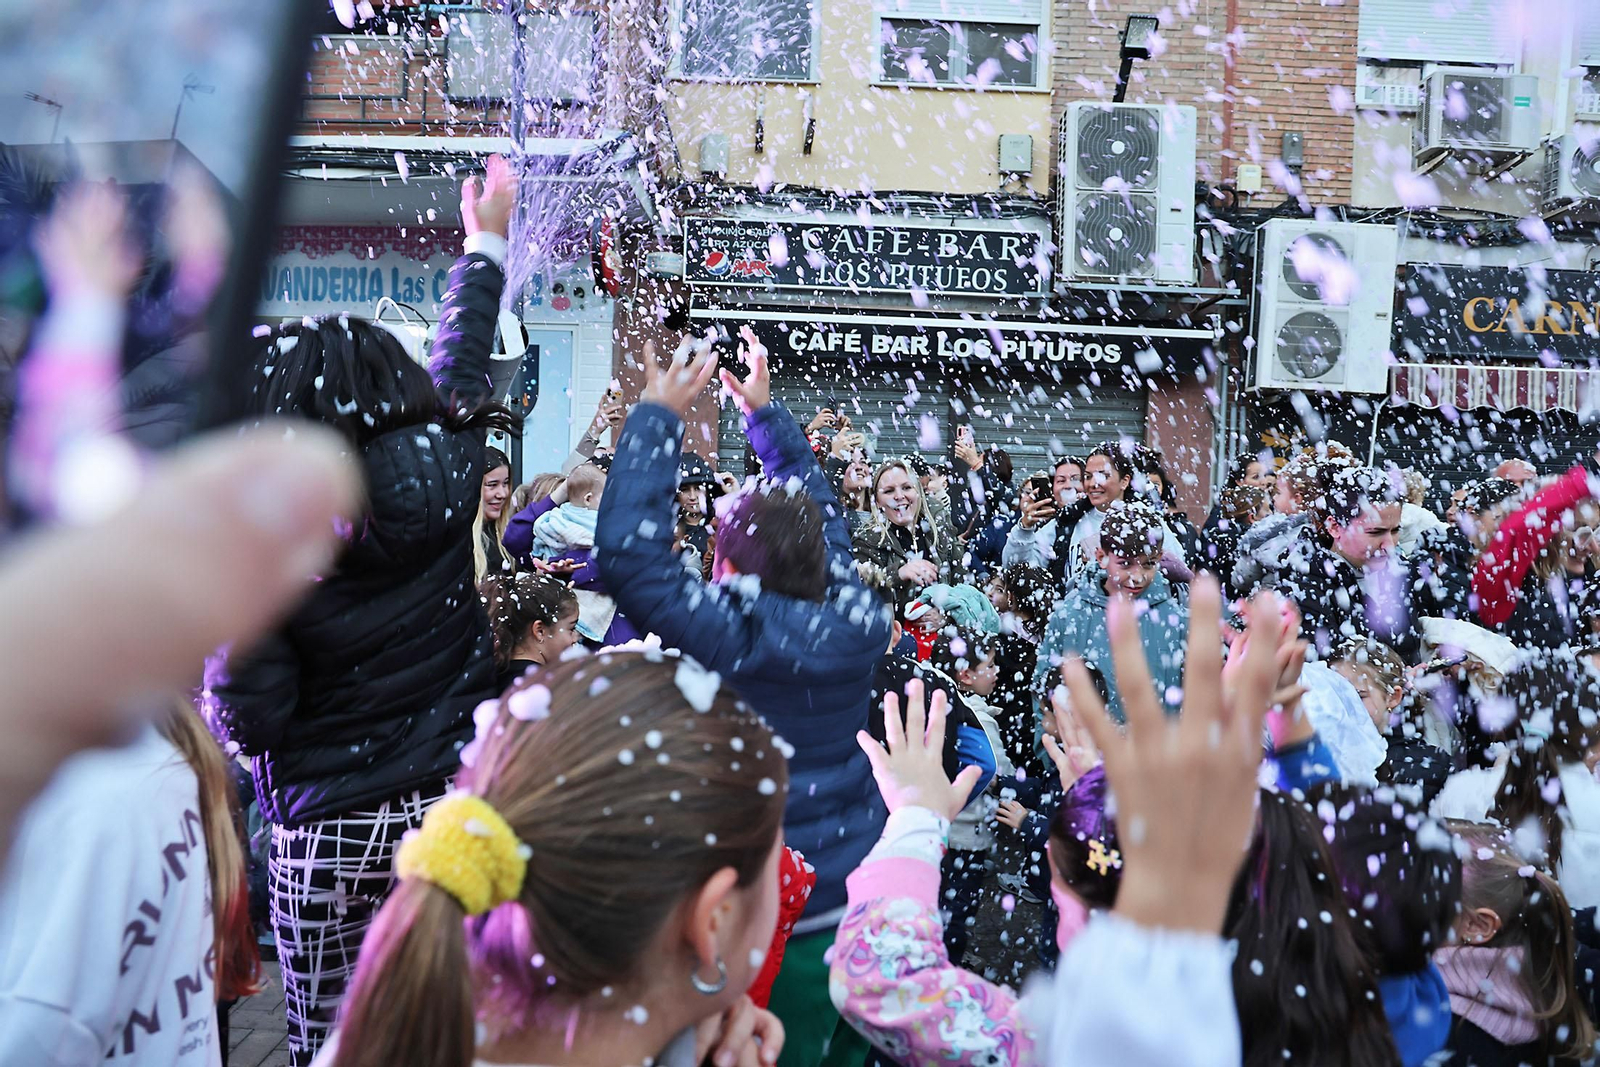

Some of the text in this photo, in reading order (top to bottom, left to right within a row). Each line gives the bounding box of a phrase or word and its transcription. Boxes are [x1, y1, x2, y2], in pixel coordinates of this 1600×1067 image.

[701, 238, 730, 248] ZRO
[731, 258, 775, 278] MAX
[820, 260, 1008, 291] LOS PITUFOS
[391, 266, 425, 304] Las
[1463, 296, 1600, 335] CARN
[789, 329, 1121, 363] CAFÉ BAR LOS PITUFOS
